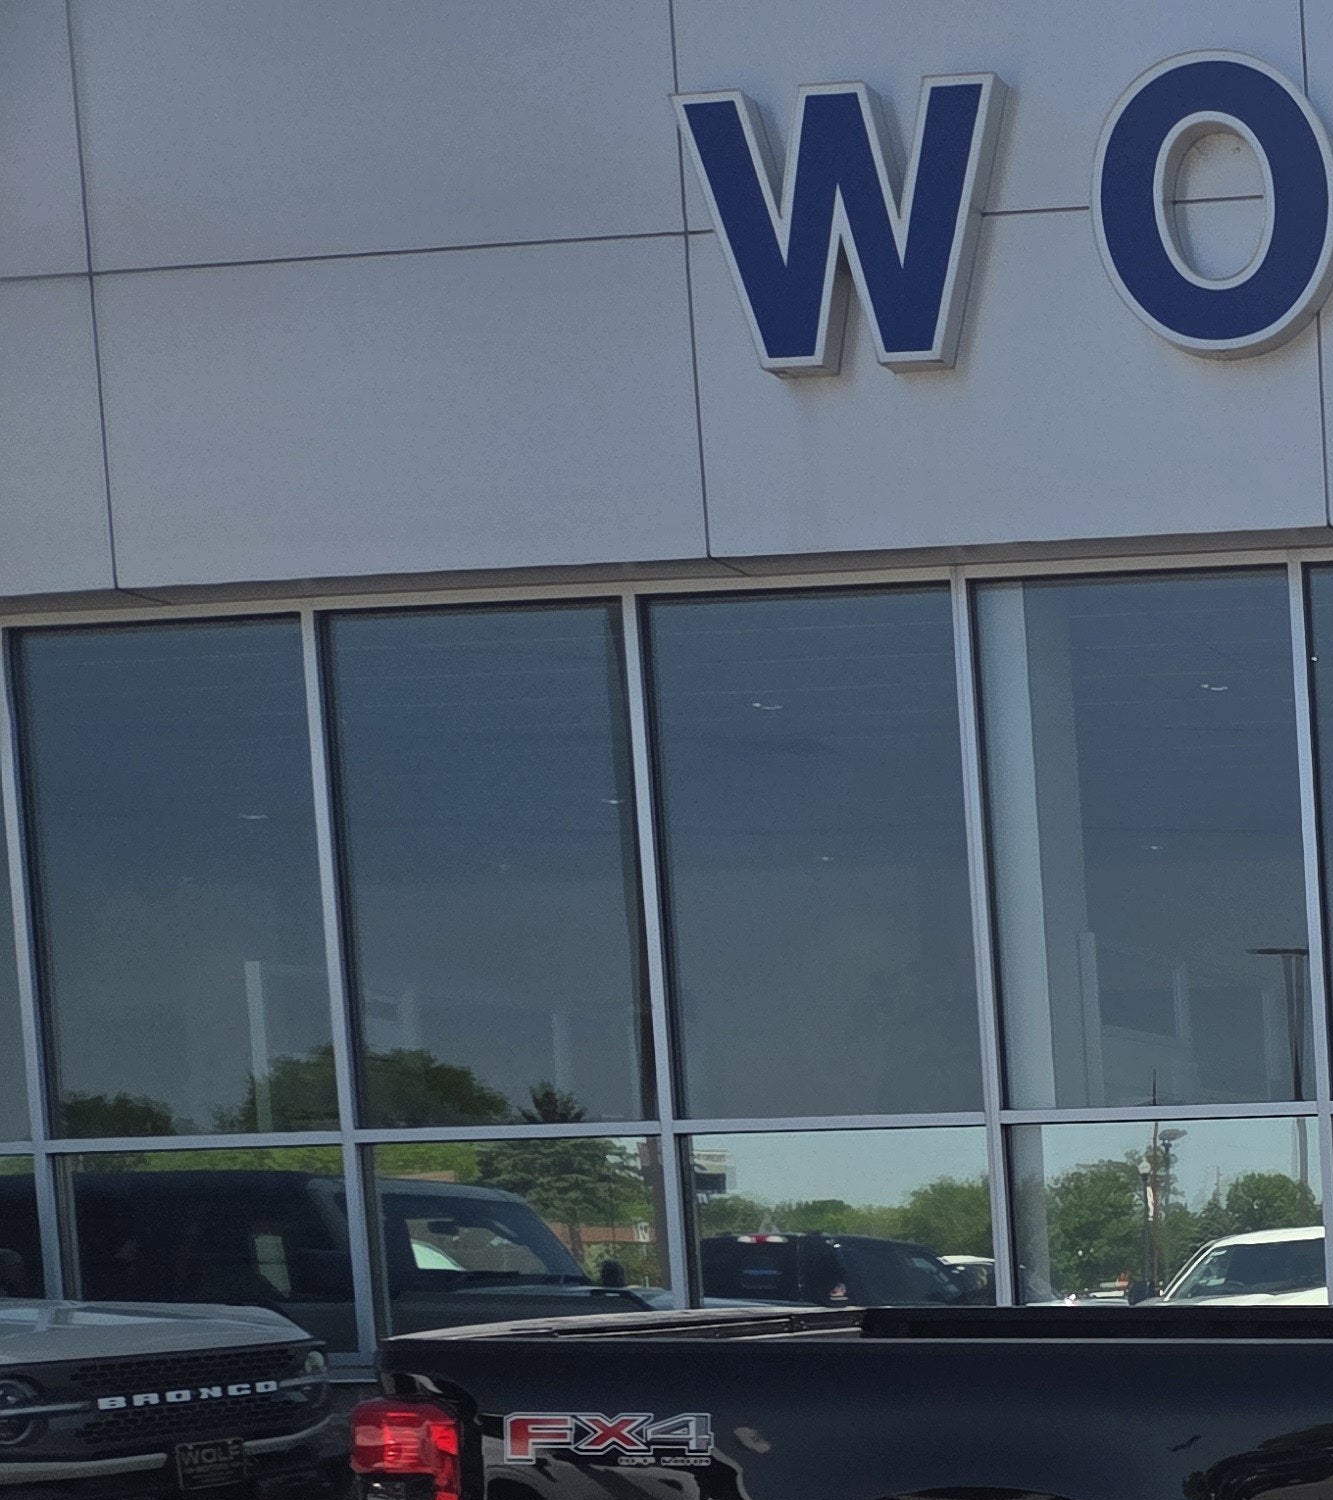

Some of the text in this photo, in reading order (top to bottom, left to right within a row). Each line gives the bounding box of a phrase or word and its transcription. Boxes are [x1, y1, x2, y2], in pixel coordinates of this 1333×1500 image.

[97, 1379, 279, 1411] BRONCO
[504, 1411, 714, 1465] FX4
[181, 1444, 241, 1466] WOLF
